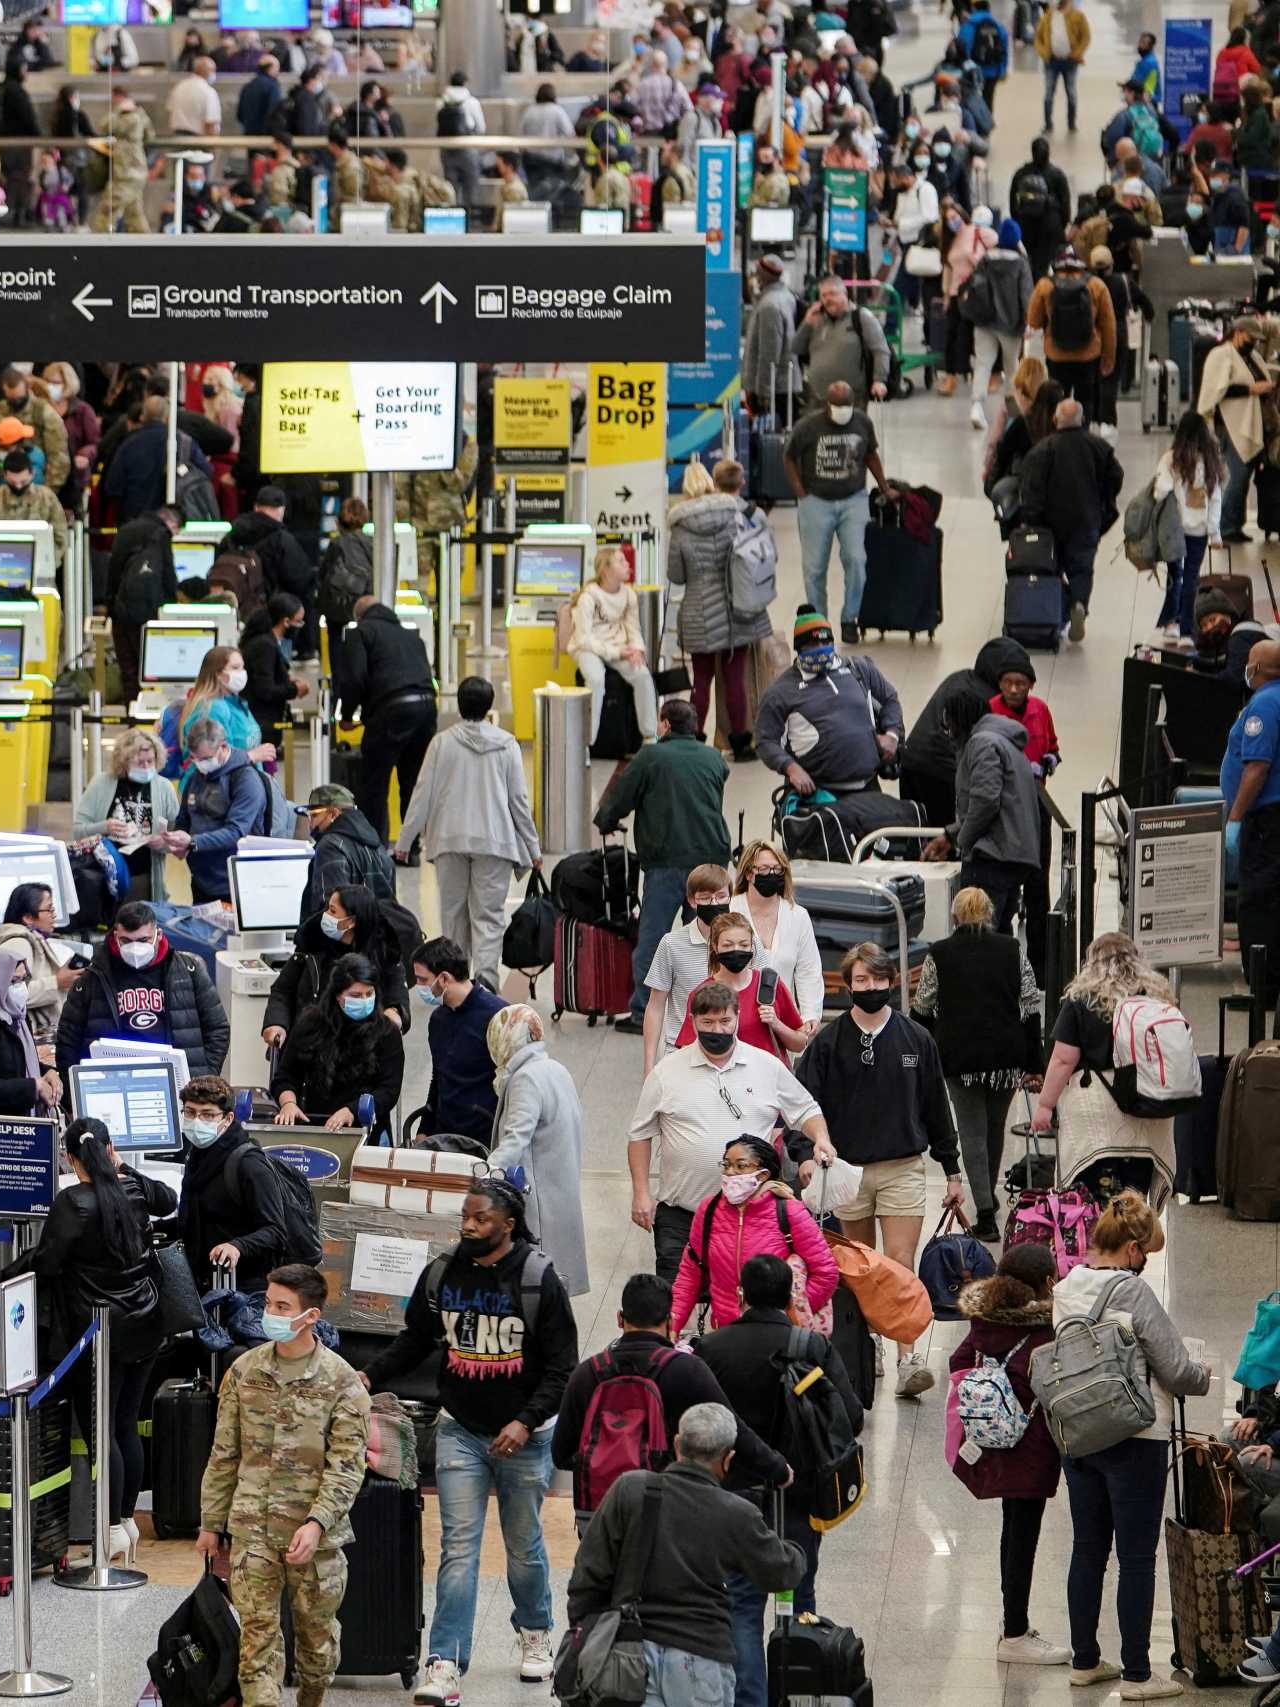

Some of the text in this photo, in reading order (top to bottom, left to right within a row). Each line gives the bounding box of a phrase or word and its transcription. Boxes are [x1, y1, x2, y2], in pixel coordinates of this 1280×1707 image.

[164, 285, 403, 309] Ground Transportation
[512, 284, 672, 308] Baggage Claim
[165, 306, 269, 321] Transporte Terrestre
[511, 306, 623, 321] Reclamo de Equipaje
[280, 388, 339, 402] Self-Tag
[376, 386, 439, 398] Get Your
[598, 374, 656, 407] Bag
[279, 404, 311, 416] Your
[376, 401, 442, 415] Boarding
[597, 405, 655, 429] Drop
[279, 420, 306, 434] Bag
[375, 419, 408, 430] Pass
[597, 511, 651, 529] Agent
[116, 988, 165, 1016] EORG
[13, 1126, 36, 1136] DESK
[21, 1165, 47, 1173] SERVICIO
